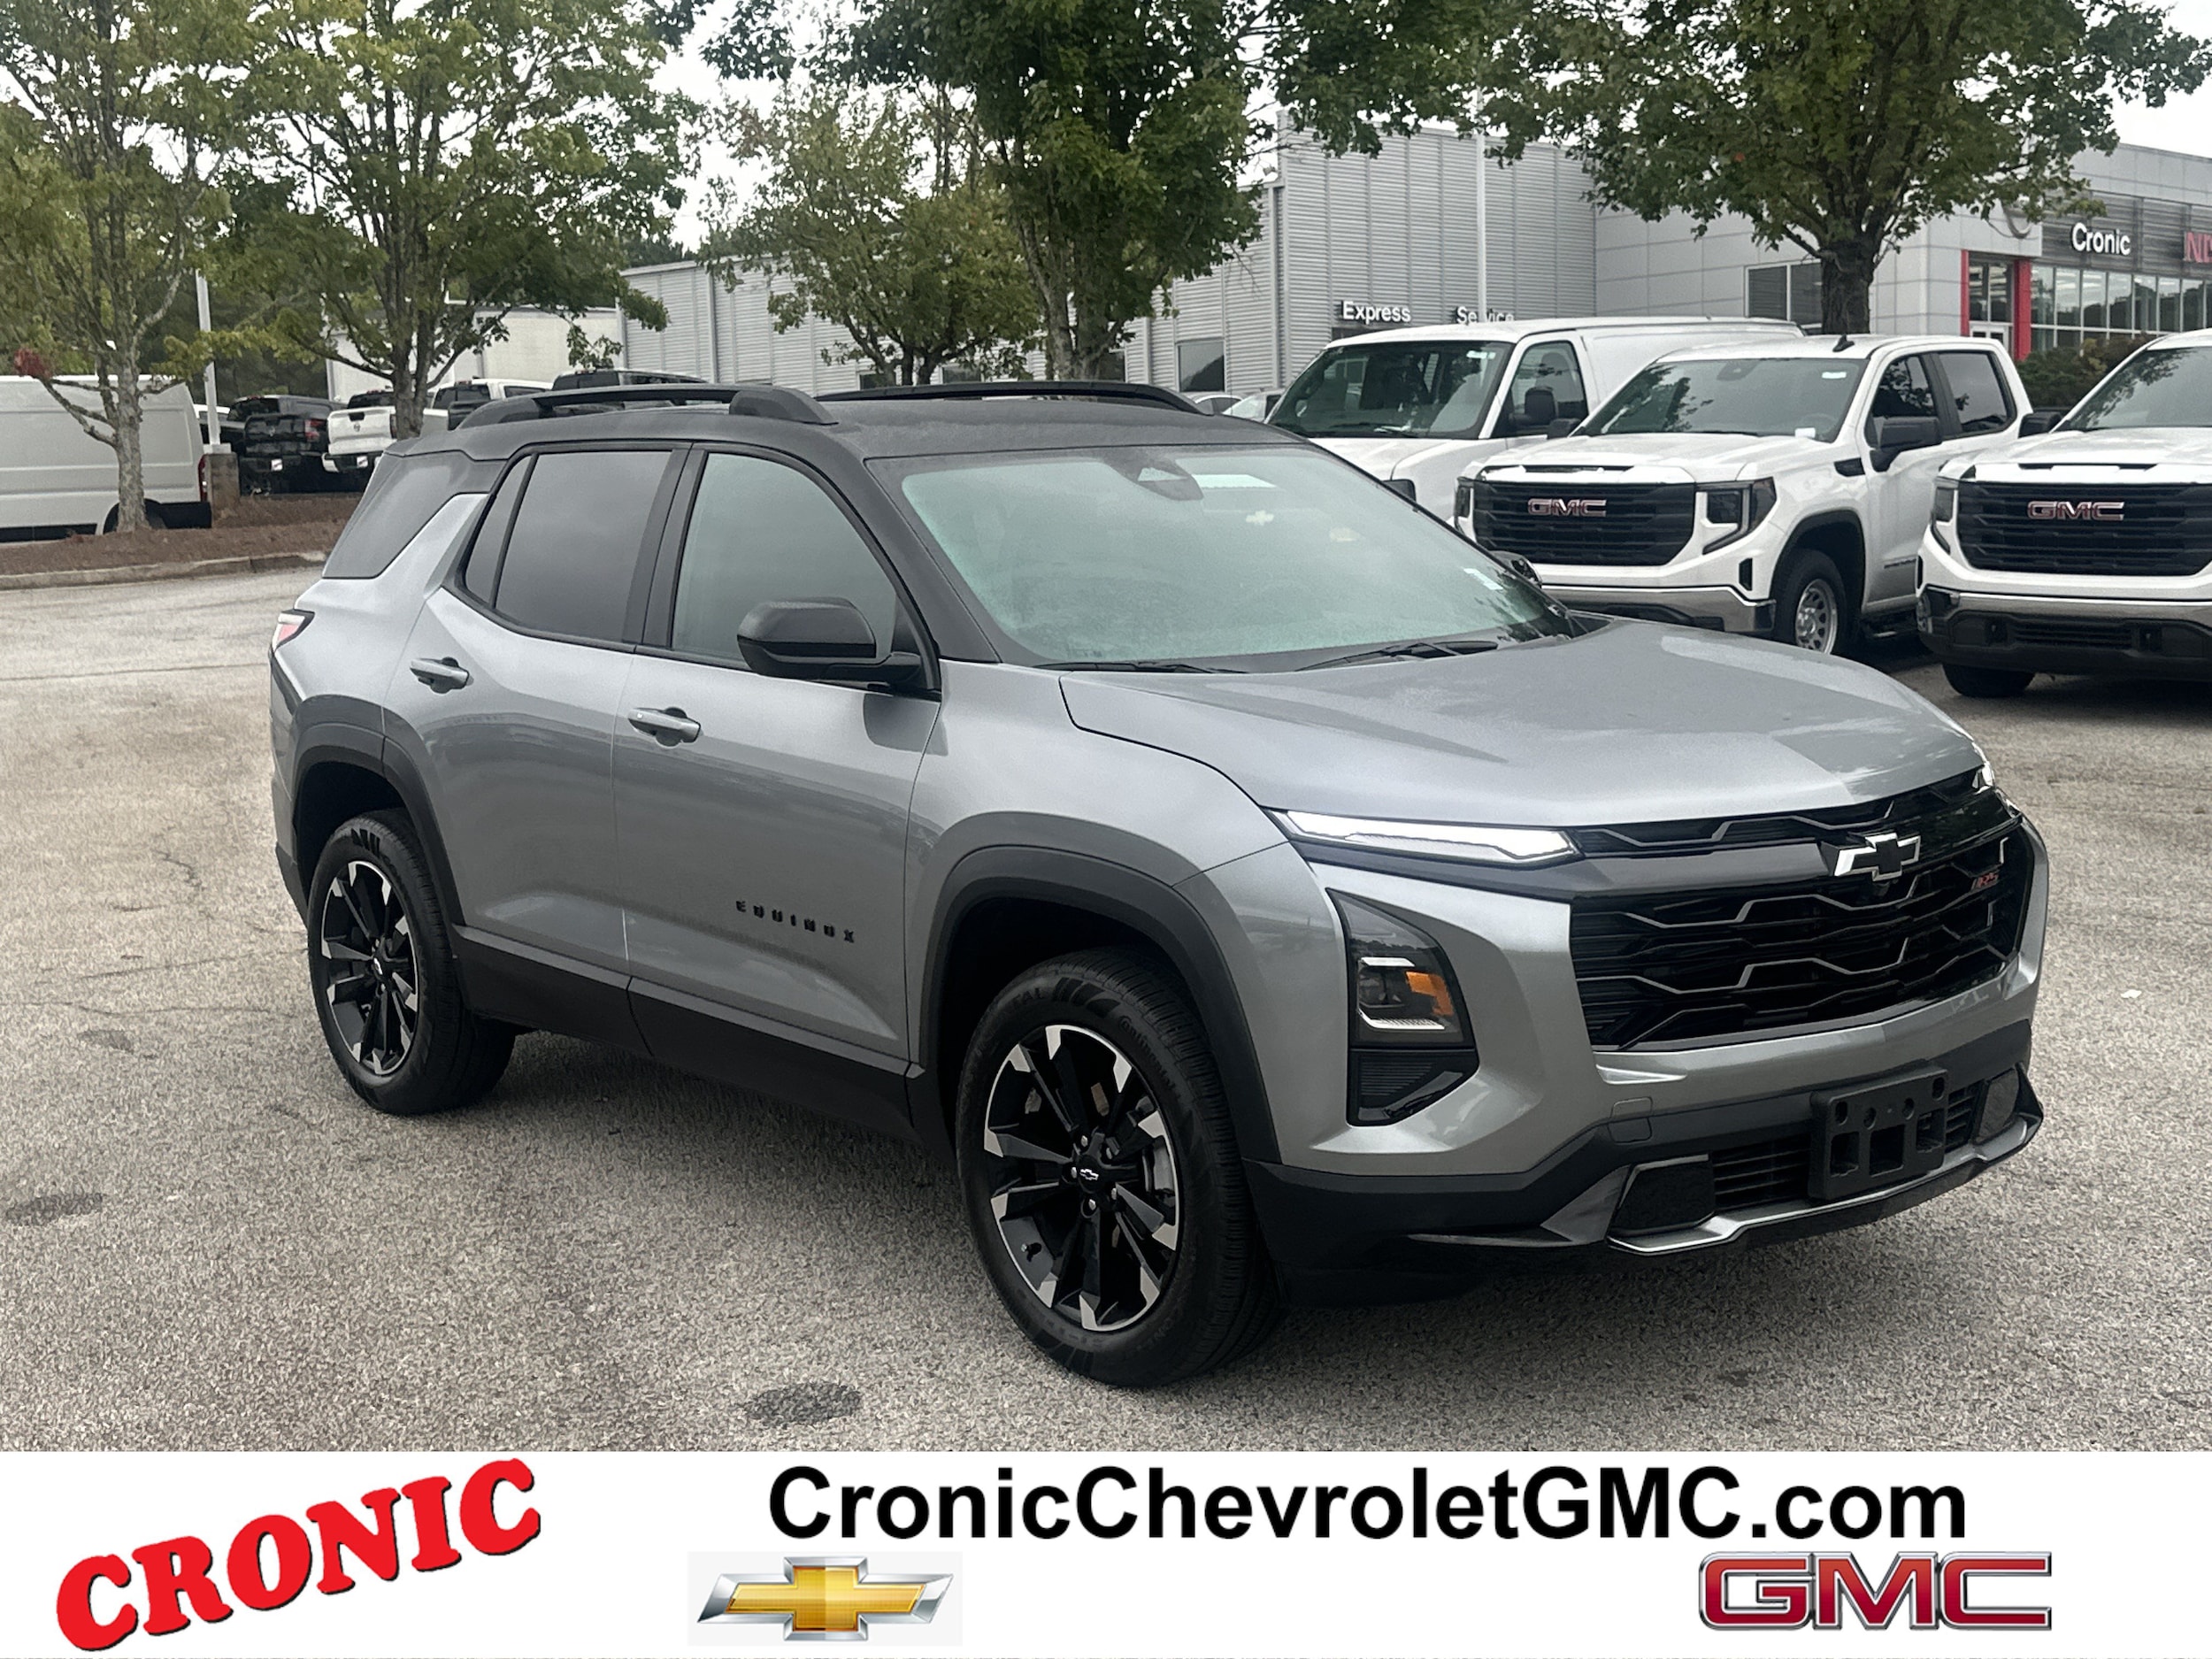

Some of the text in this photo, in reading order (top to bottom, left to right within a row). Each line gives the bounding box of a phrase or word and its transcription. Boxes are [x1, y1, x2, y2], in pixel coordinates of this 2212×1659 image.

[2071, 222, 2212, 264] Cronic NI
[1342, 301, 1514, 324] Express Sevice
[1527, 498, 1607, 518] GMC
[2027, 501, 2124, 521] GMC
[1975, 872, 2000, 888] RS
[735, 900, 855, 944] EQUINOX
